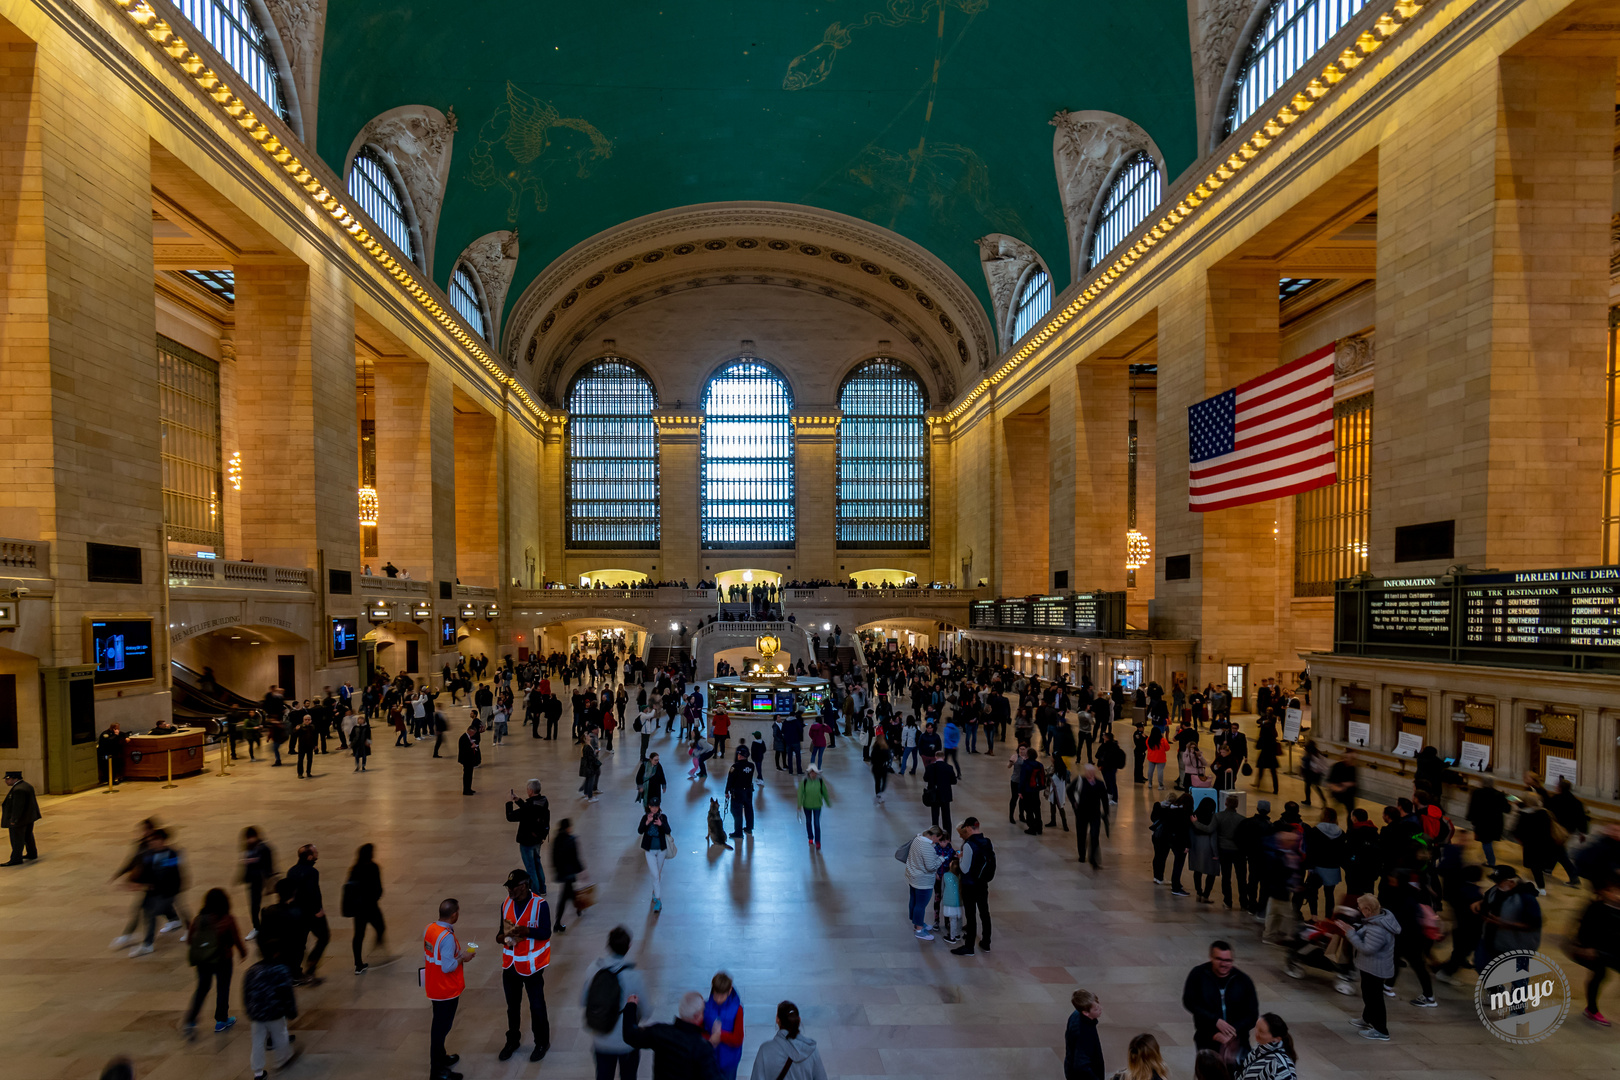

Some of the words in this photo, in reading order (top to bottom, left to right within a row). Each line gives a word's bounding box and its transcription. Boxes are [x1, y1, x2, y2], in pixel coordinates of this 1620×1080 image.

[1516, 572, 1559, 582] HARLEM
[1562, 571, 1586, 580] LINE
[1384, 578, 1435, 587] INFORMATION
[273, 618, 292, 628] STREET
[171, 633, 183, 643] HE
[183, 621, 211, 636] METLIFE
[212, 616, 240, 626] BUILDING
